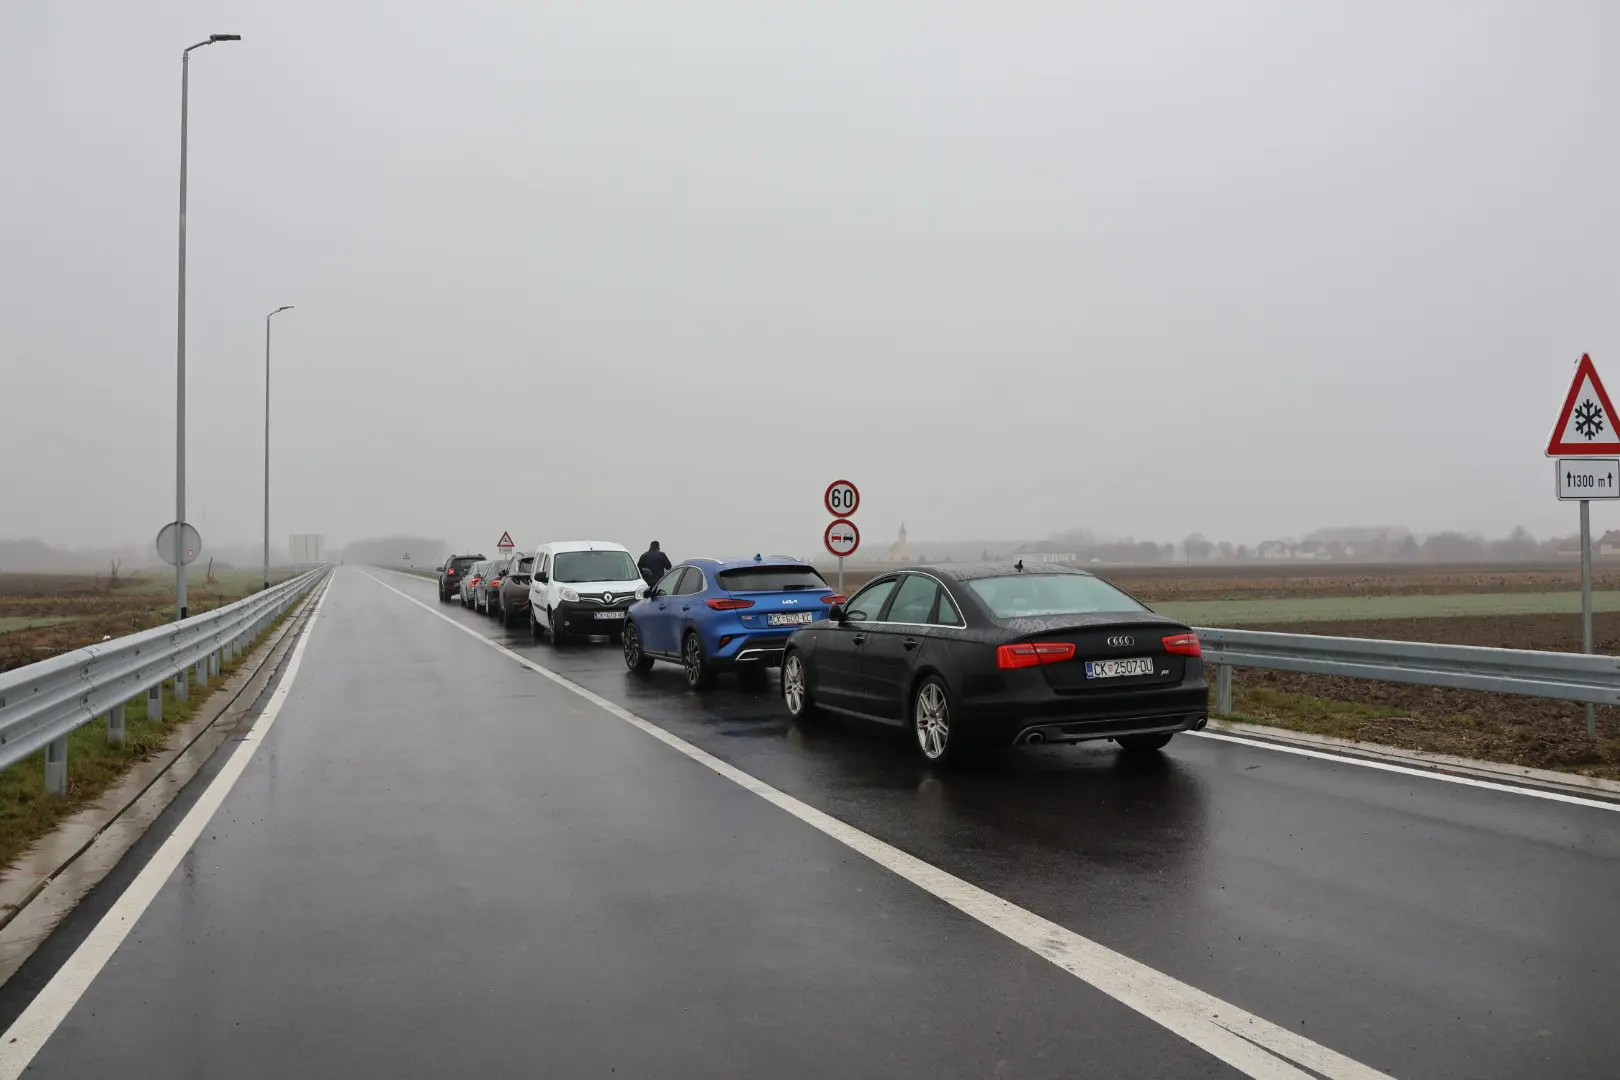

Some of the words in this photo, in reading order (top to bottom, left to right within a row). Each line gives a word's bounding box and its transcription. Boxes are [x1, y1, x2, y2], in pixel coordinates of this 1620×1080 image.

[1572, 474, 1594, 488] 1300
[1598, 478, 1606, 487] m
[831, 488, 853, 508] 60
[1094, 662, 1107, 676] CK
[1114, 659, 1153, 675] 2507-DU
